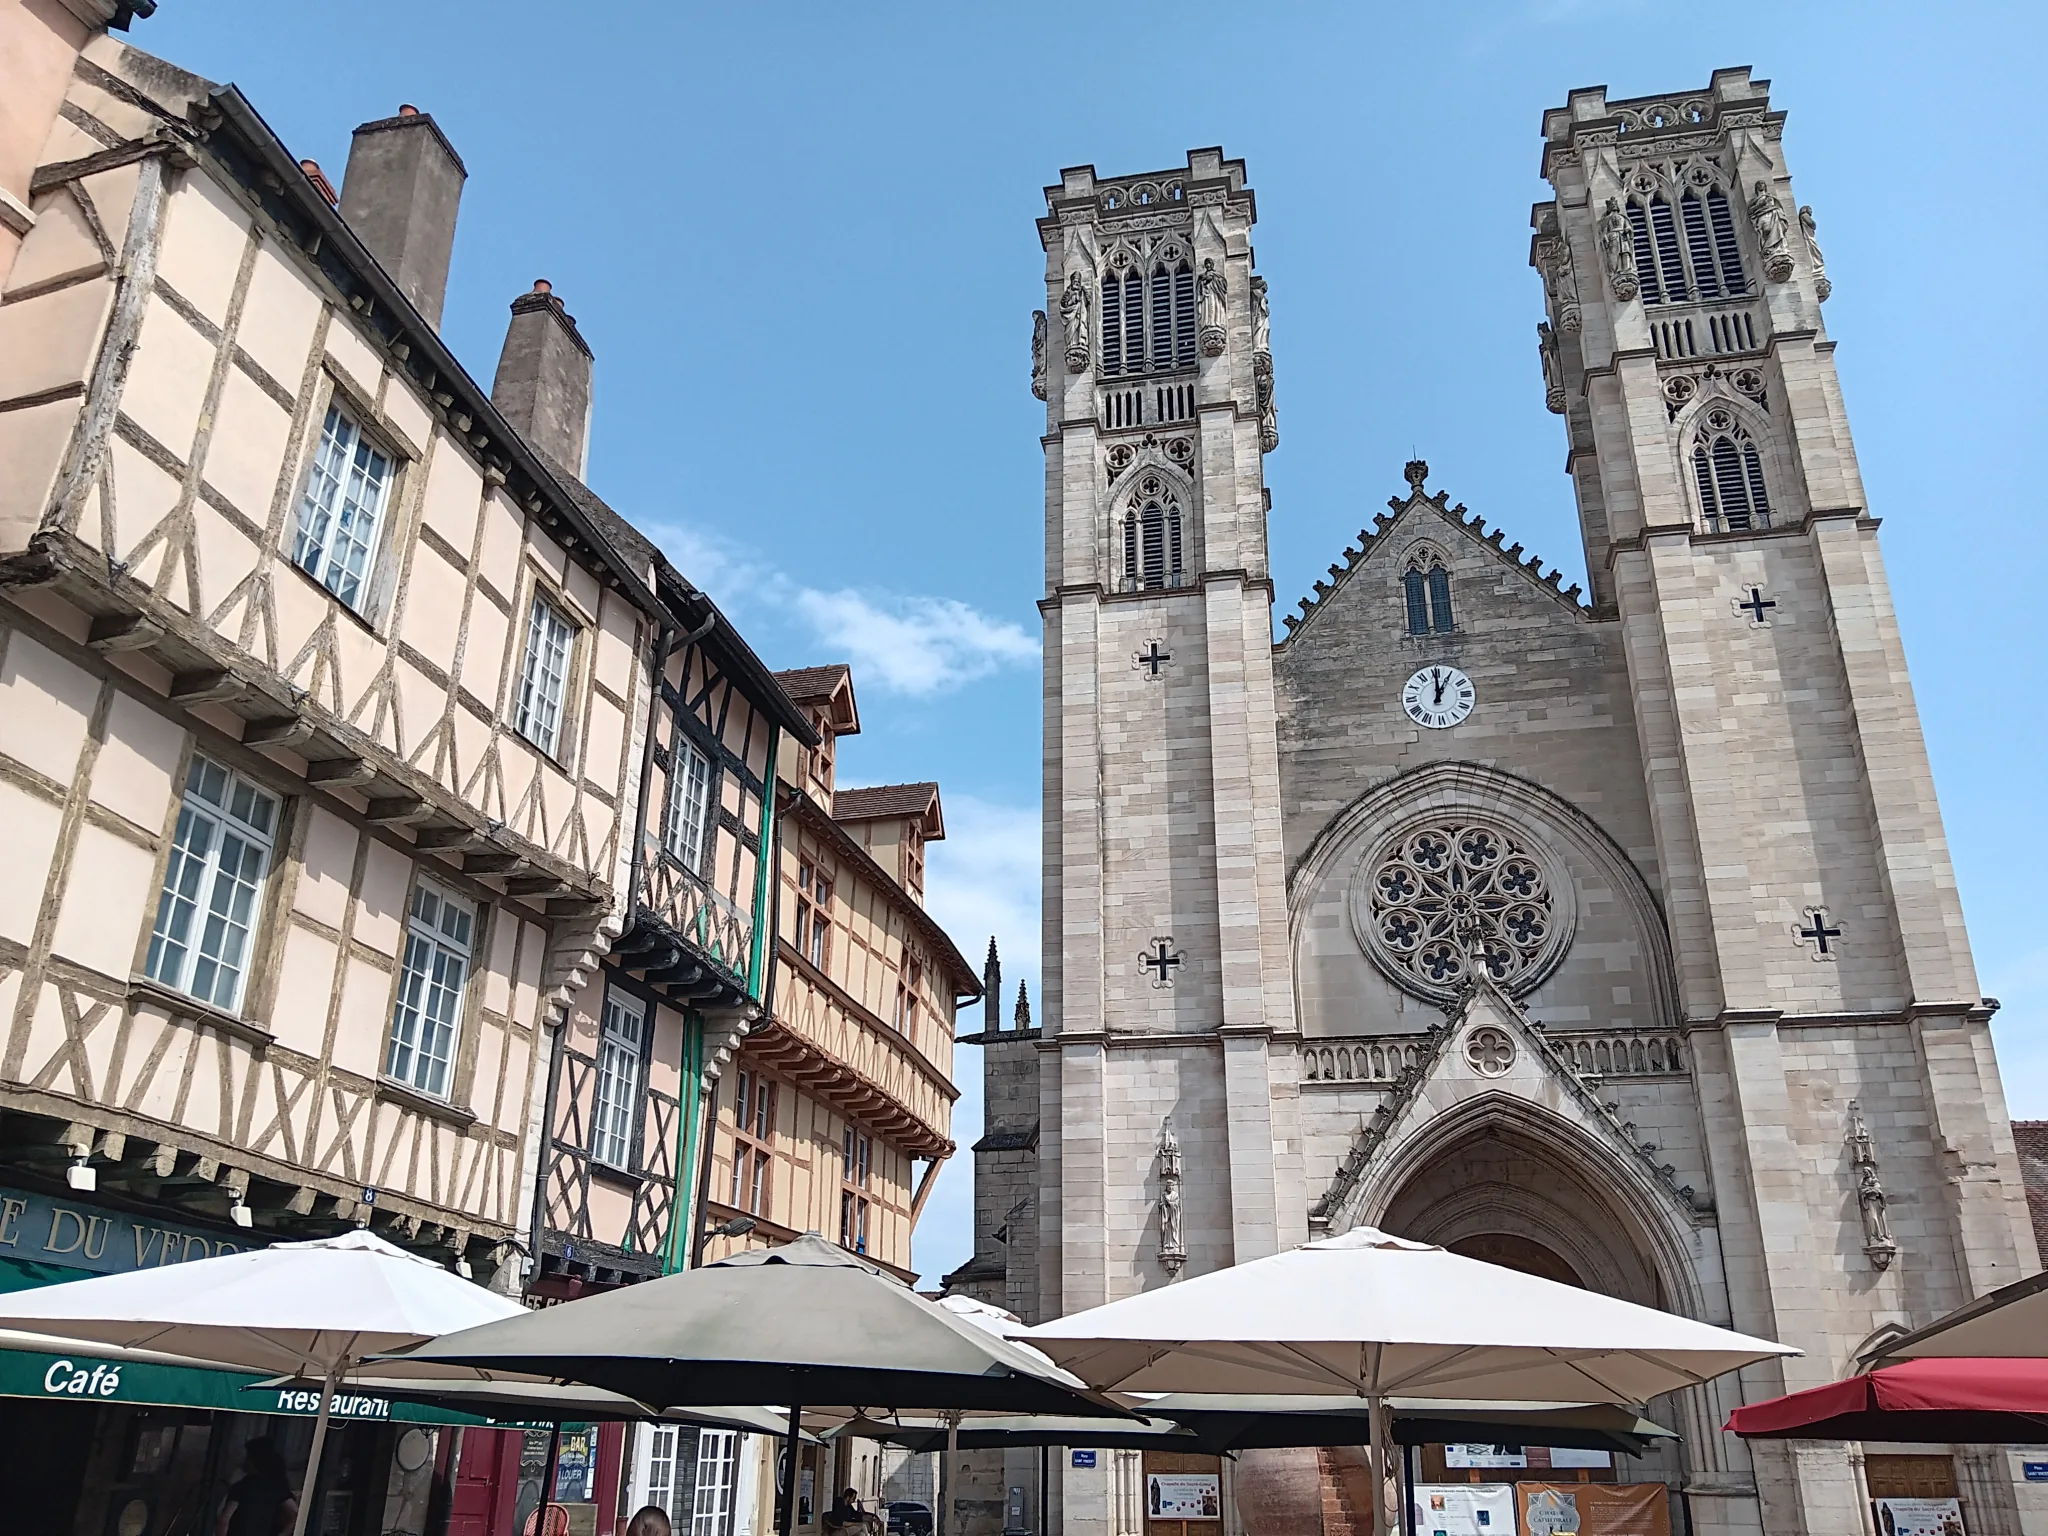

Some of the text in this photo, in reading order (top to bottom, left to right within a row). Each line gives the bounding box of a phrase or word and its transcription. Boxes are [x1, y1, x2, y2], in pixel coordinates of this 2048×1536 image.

[365, 1189, 373, 1201] 8
[42, 1207, 113, 1260] DU
[566, 1246, 572, 1257] 6
[44, 1360, 123, 1396] Café
[277, 1390, 390, 1417] Resaurant
[570, 1436, 586, 1452] BAR
